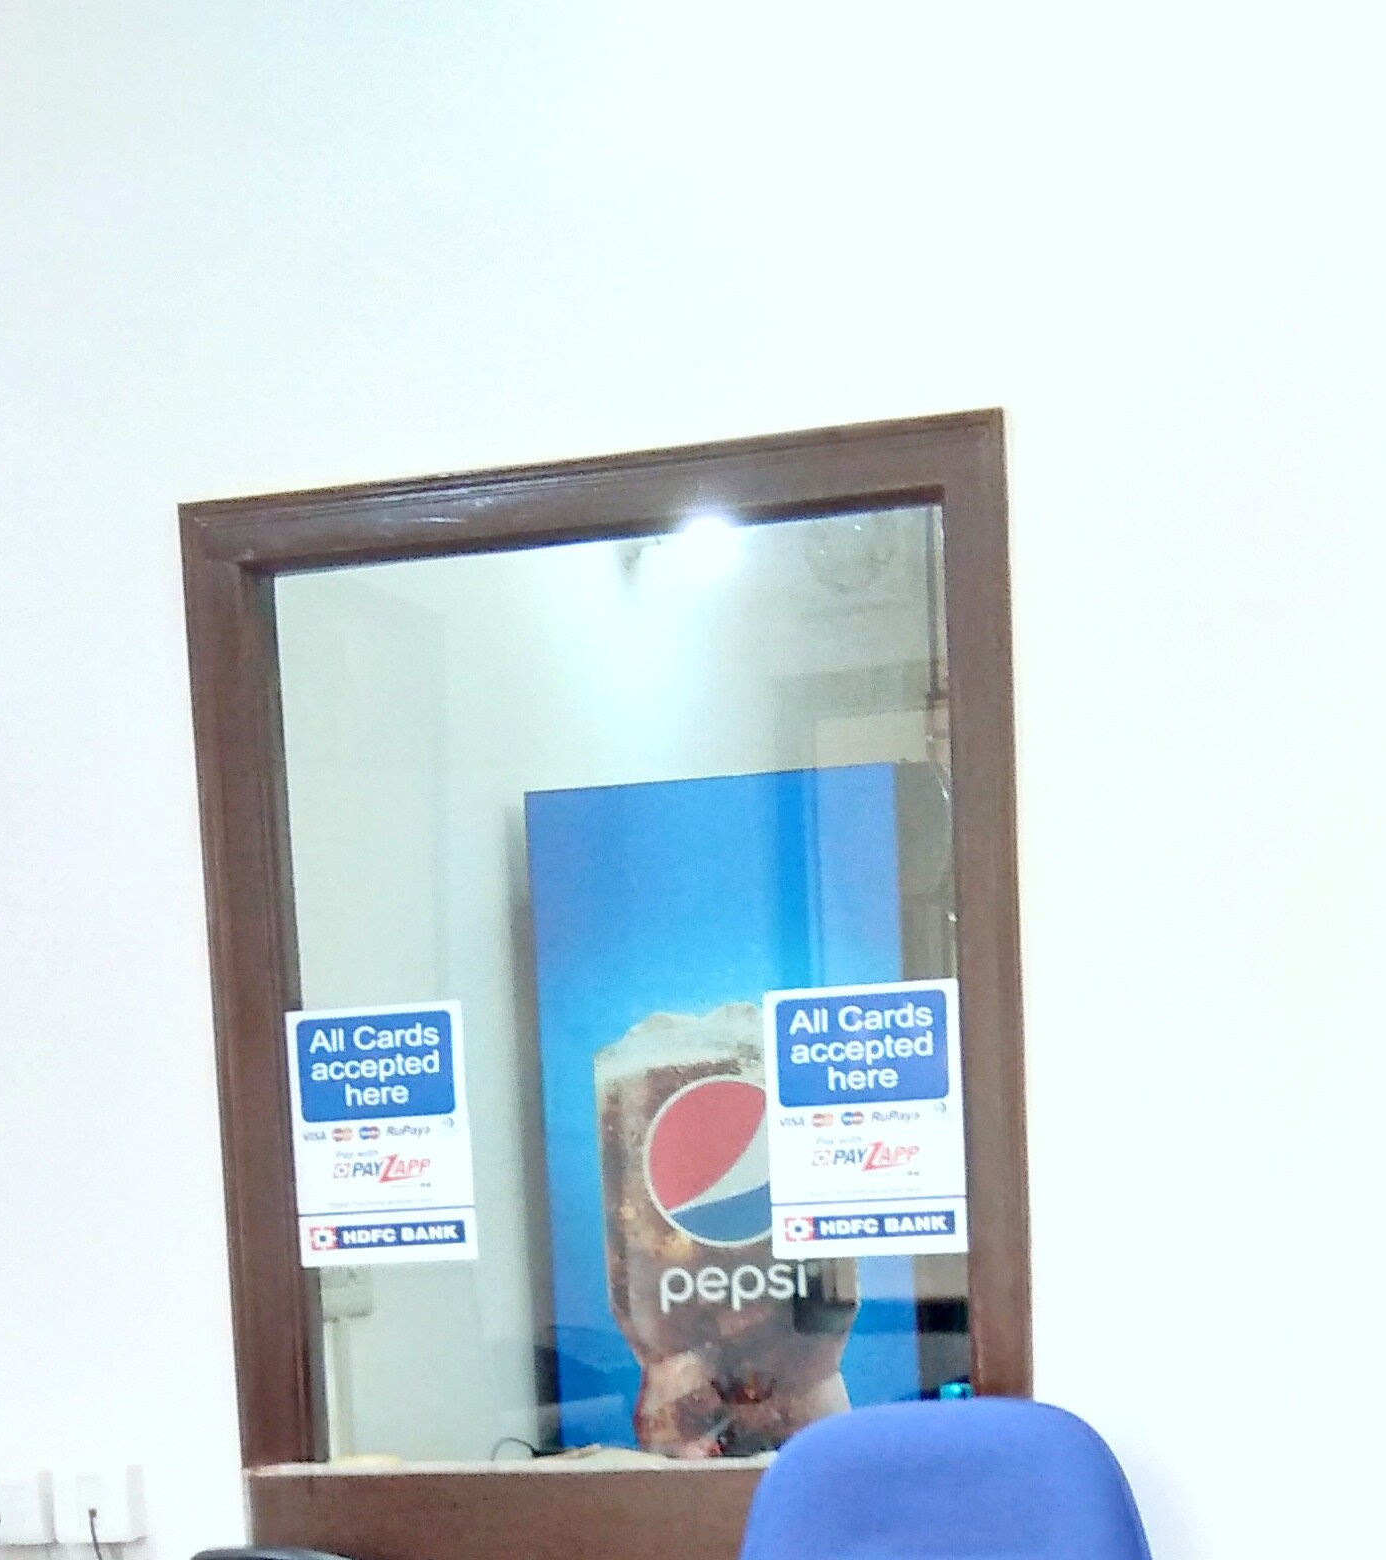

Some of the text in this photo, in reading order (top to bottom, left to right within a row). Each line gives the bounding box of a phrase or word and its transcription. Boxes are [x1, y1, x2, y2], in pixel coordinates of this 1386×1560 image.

[789, 1002, 934, 1036] All Cards
[309, 1022, 441, 1054] All Cards
[790, 1030, 934, 1065] accepted
[311, 1051, 441, 1083] accepted
[827, 1066, 899, 1091] here
[344, 1083, 410, 1107] here
[342, 1223, 458, 1245] HDFC BANK
[820, 1214, 949, 1236] HDFC BANK
[660, 1260, 809, 1313] pepsi
